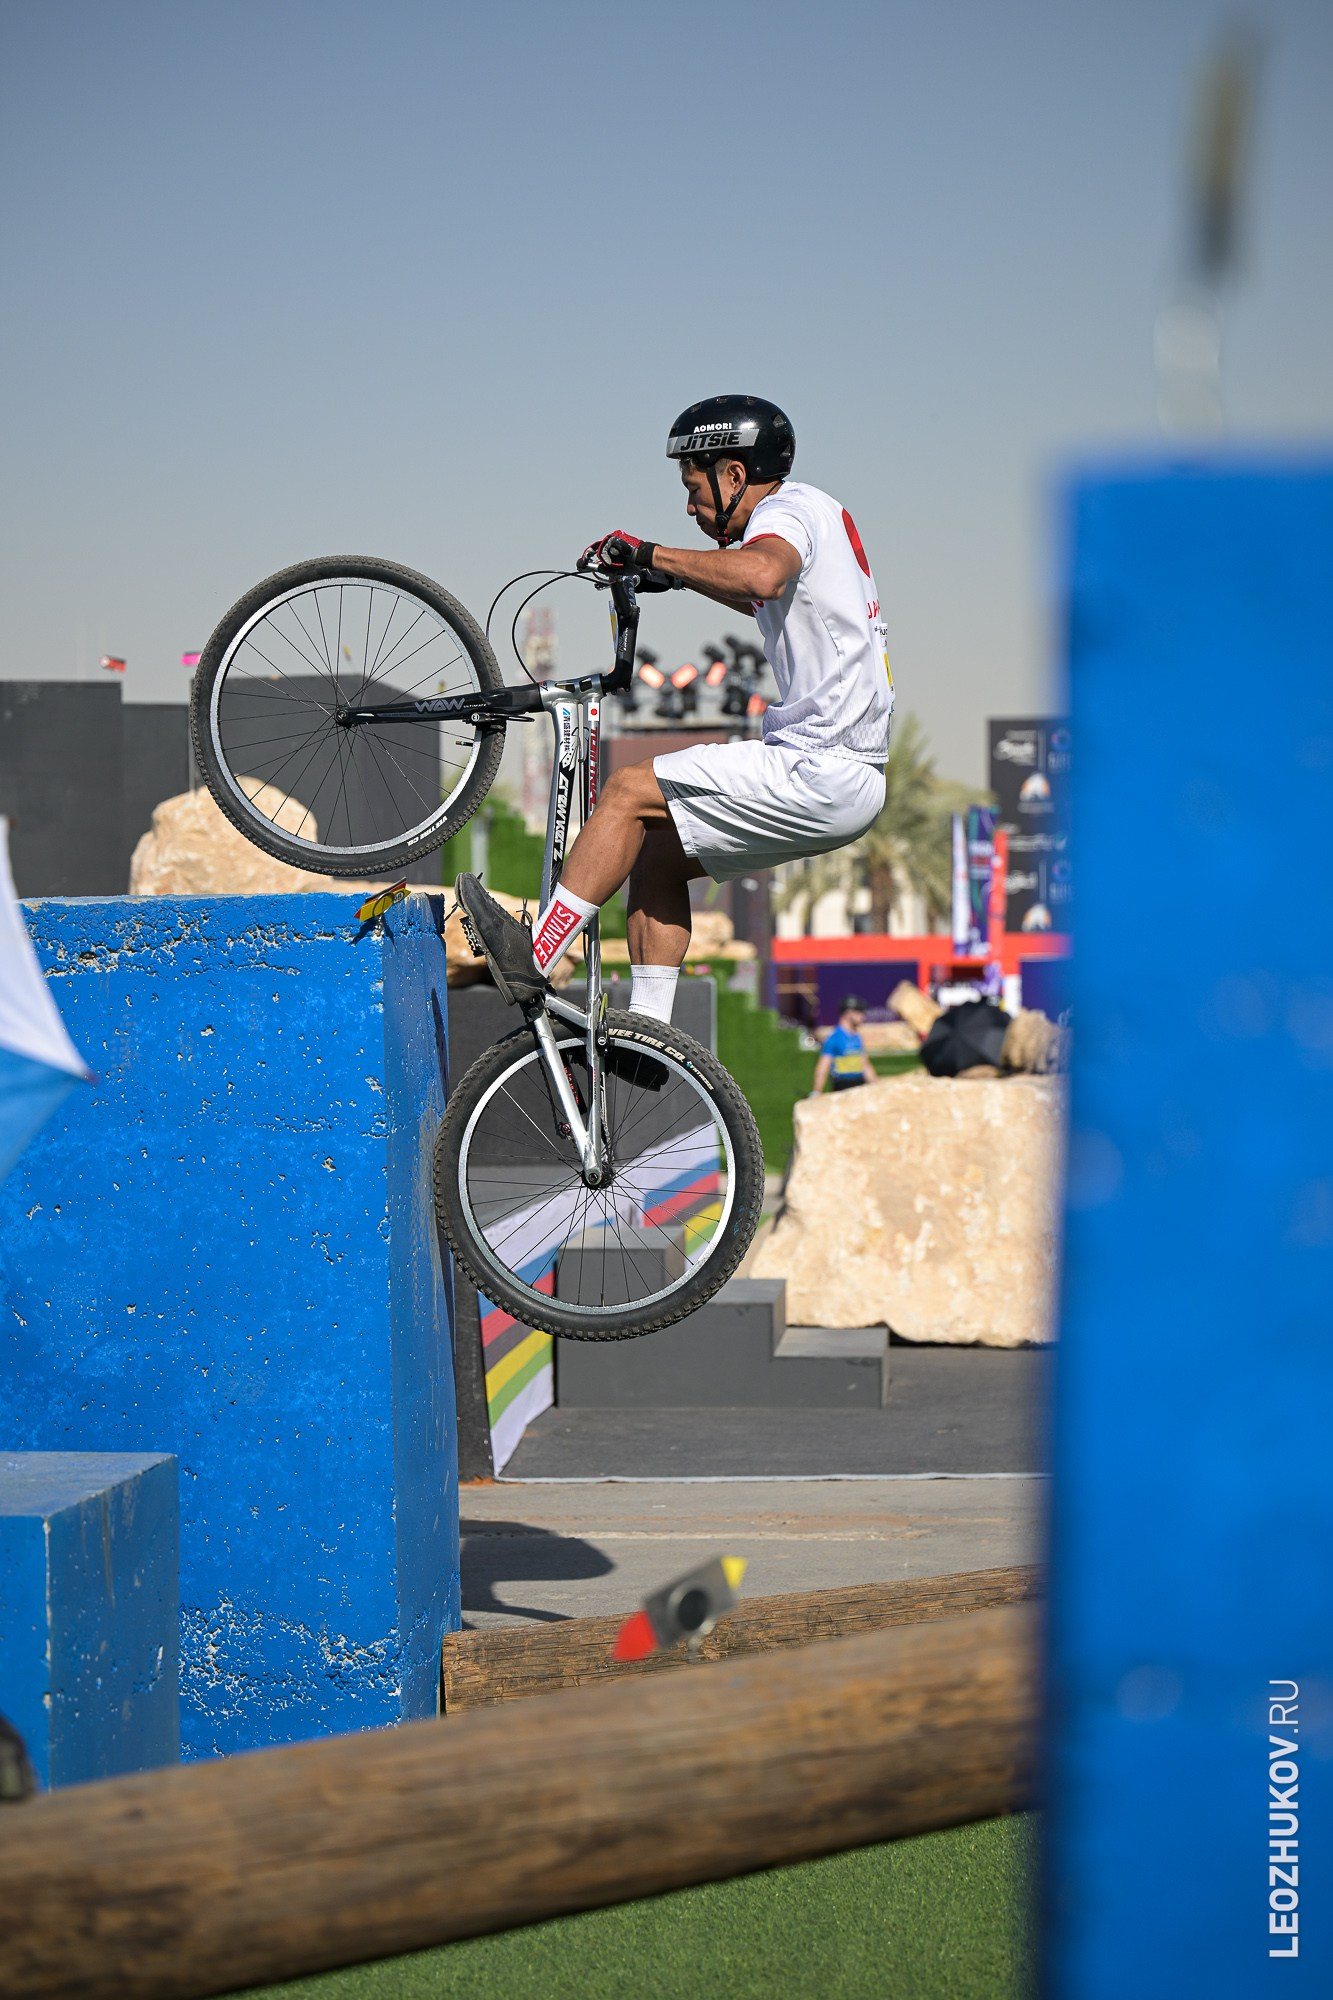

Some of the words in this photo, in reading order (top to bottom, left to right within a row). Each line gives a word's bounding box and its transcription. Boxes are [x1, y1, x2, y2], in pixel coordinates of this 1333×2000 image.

[693, 423, 732, 434] AOMORI
[535, 905, 575, 964] STANCE
[608, 1028, 634, 1039] VEE
[634, 1032, 666, 1049] TIRE
[664, 1046, 687, 1063] CO.
